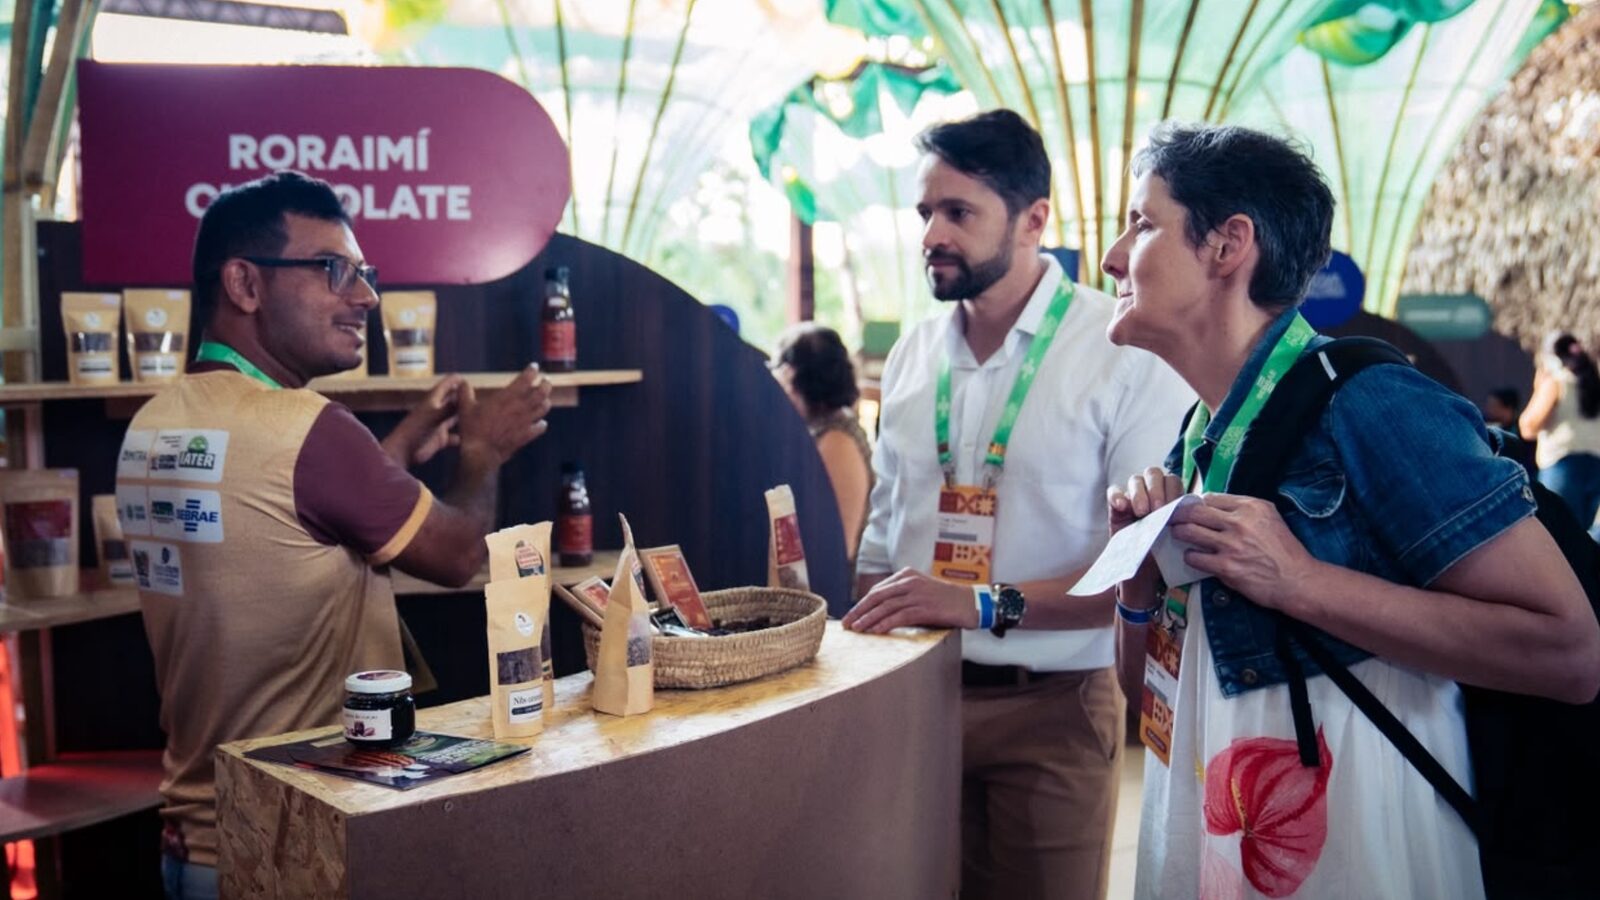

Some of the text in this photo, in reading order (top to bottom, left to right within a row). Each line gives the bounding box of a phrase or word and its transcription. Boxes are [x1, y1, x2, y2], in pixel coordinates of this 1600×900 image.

[228, 128, 431, 170] RORAIMÍ
[185, 182, 471, 220] COLATE
[176, 508, 218, 523] SEBRAE
